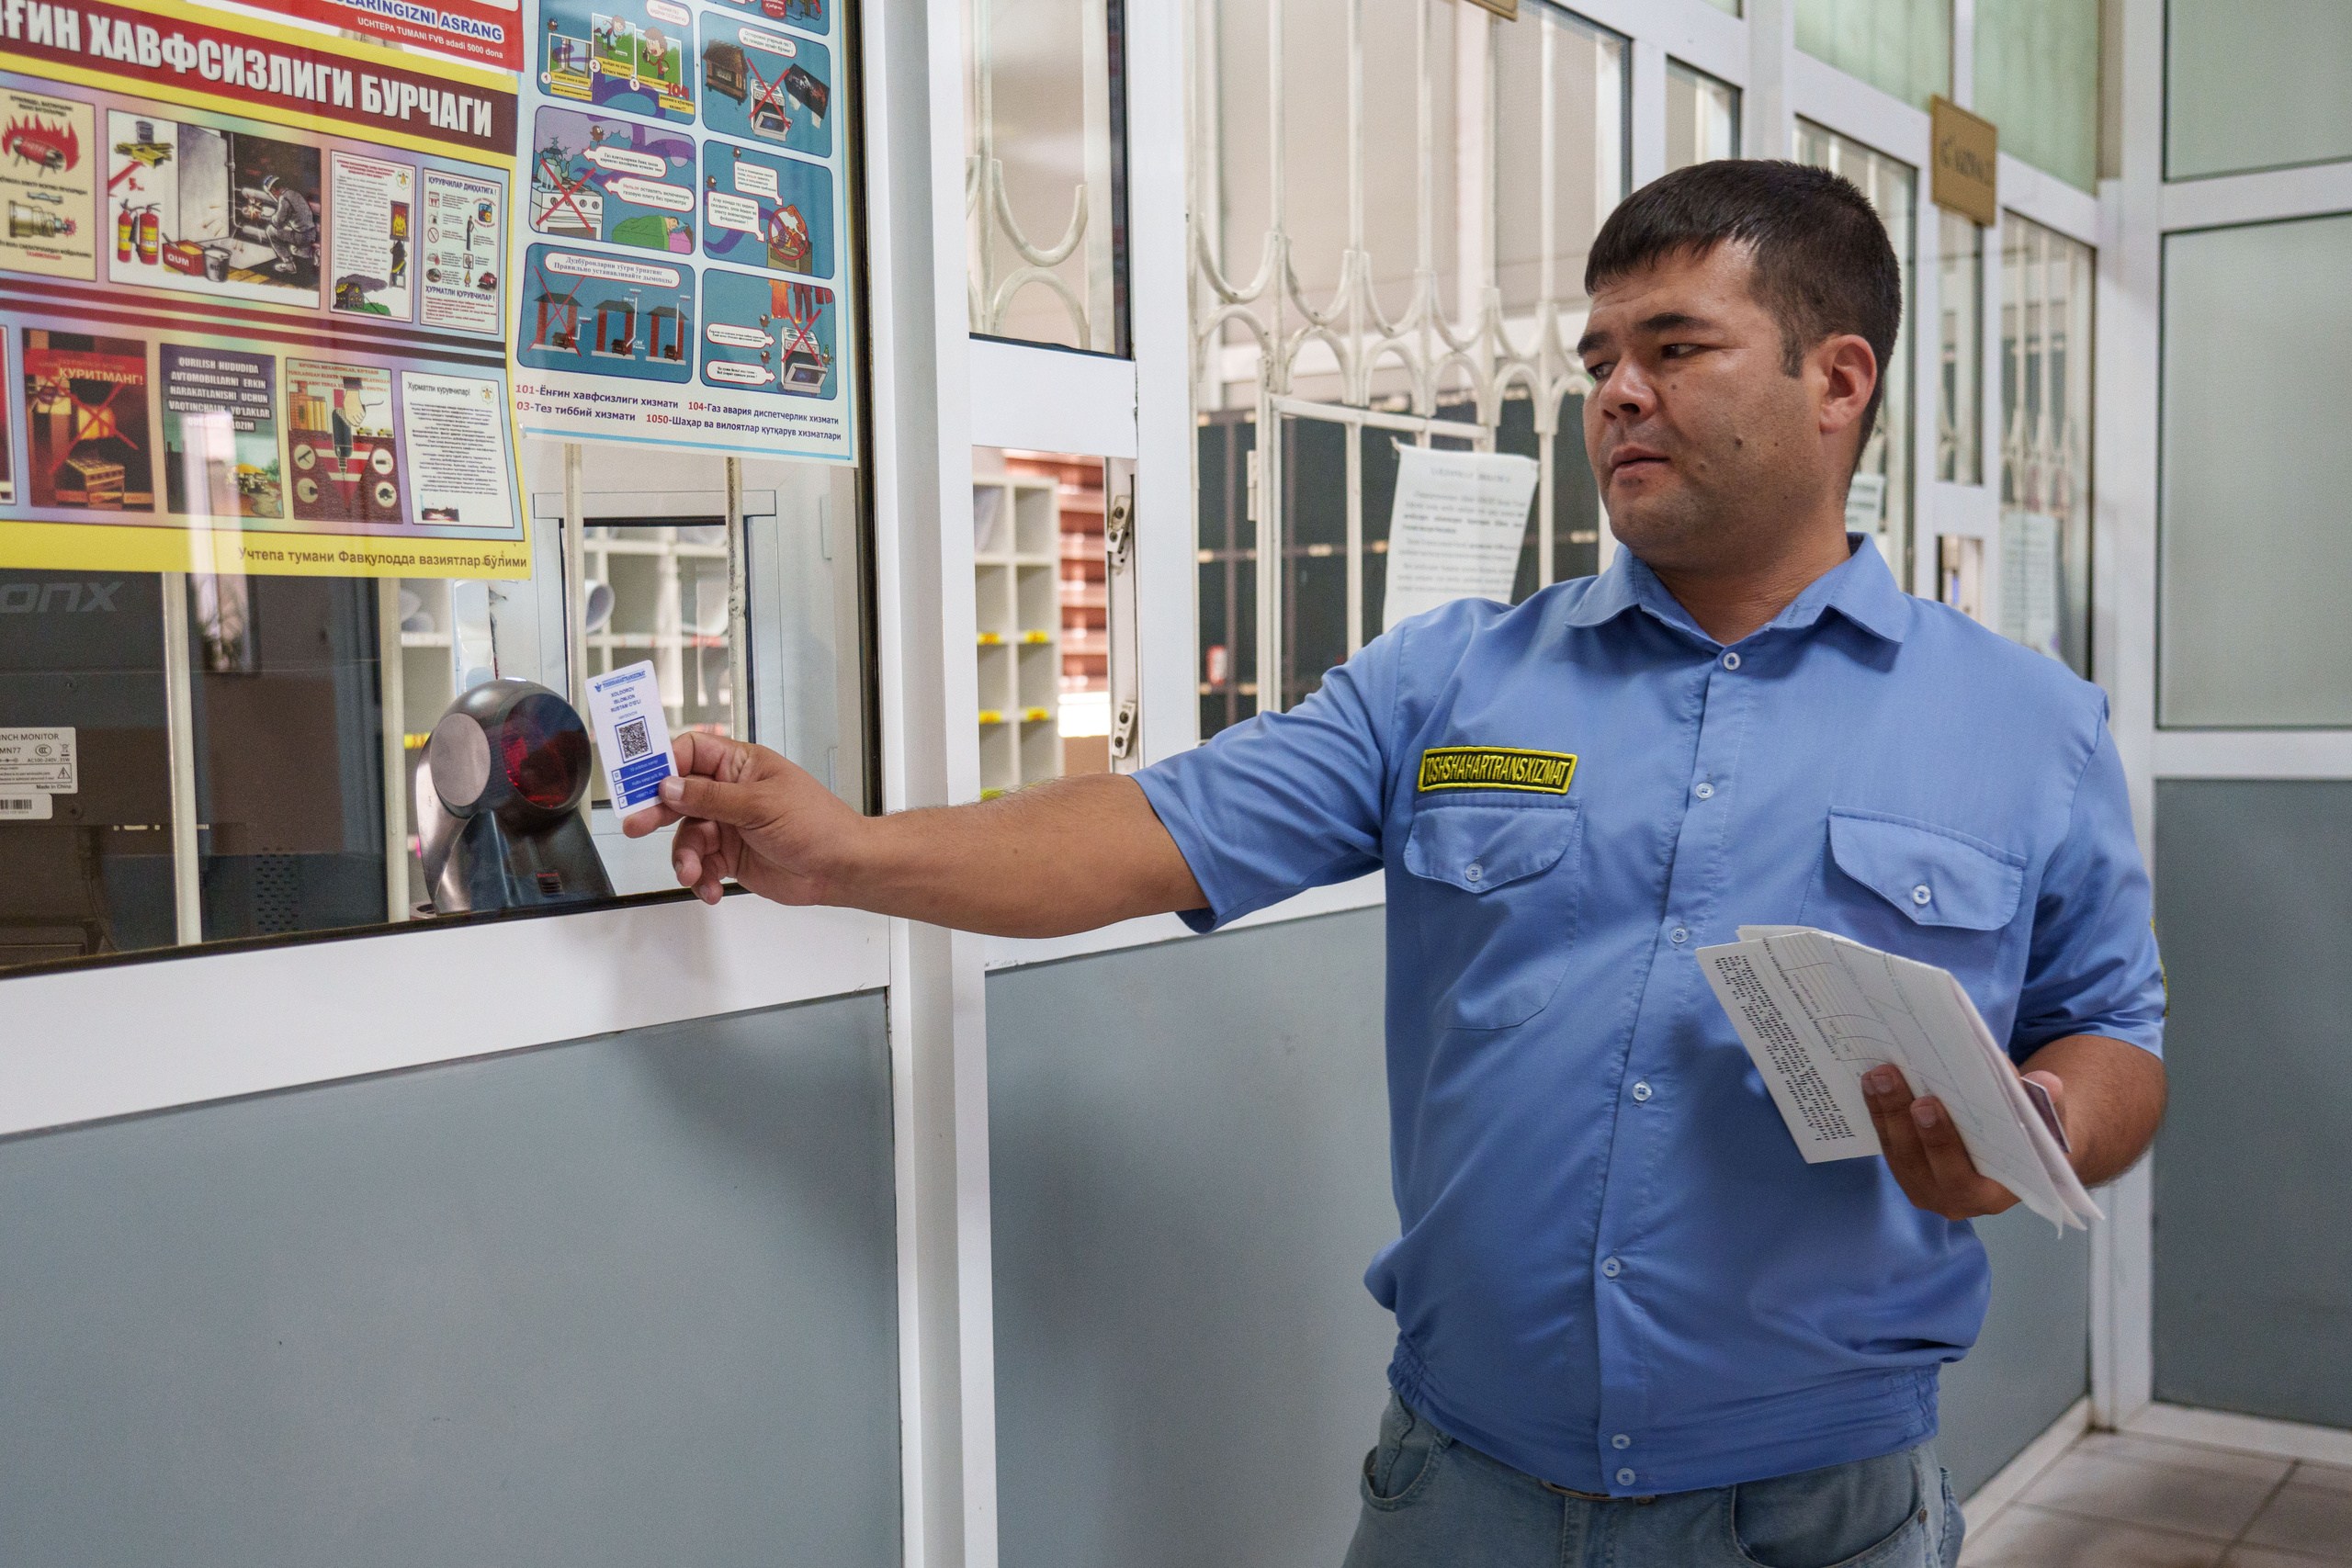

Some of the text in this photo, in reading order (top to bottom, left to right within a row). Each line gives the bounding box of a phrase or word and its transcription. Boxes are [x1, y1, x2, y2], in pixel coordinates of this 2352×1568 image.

[336, 0, 503, 40] ARINGIZNI ASRANG
[357, 17, 503, 59] UCHTEPA TUMANI FVB adadi 5000 dona
[744, 30, 766, 41] Осторожно
[87, 13, 354, 109] ХАВФСИЗЛИГИ
[360, 73, 492, 139] БУРЧАГИ
[666, 81, 689, 101] 104
[428, 175, 463, 190] ҚУРУВЧИЛАР
[463, 183, 493, 196] ДИҚҚАТИГА
[623, 183, 639, 191] Нельзя
[623, 190, 641, 198] газовую
[166, 254, 189, 266] QUM
[593, 267, 641, 279] устанавливайте
[457, 290, 492, 301] ҚУРУВЧИЛАР
[178, 356, 259, 374] QURILISH HUDUDIDA
[171, 371, 266, 389] AVTOMOBILLARNI ERKIN
[169, 386, 268, 403] HARAKATLANISHI UCHUN
[515, 384, 679, 409] 101-Ёнғин хавфсизлиги хизмати
[168, 400, 270, 418] VAQTINCHALIK YO'LAKLAR
[516, 401, 636, 422] 03-Тез тиббий хизмати
[688, 401, 839, 424] 104-Газ авария диспетчерлик хизмати
[232, 420, 254, 431] LOZIM
[646, 414, 702, 428] 1050-Шаҳар
[716, 423, 760, 433] вилоятлар
[761, 426, 797, 436] қутқарув
[797, 430, 842, 441] хизматлари
[238, 547, 527, 569] Учтепа тумани Фавқулодда вазиятлар бўлими
[1424, 754, 1570, 786] TOSHSHAHARTRANSXIZMAT
[1714, 958, 1732, 985] boylik
[1735, 956, 1741, 965] va
[1732, 991, 1740, 999] va
[1741, 1006, 1764, 1038] manfaat
[1768, 1010, 1790, 1041] moddiy,
[1720, 958, 1830, 1140] orttirish maqsadida foydalanish, naqd pul
[1728, 957, 1838, 1139] tushumini to'liq topshirmaslik, yo'lovchilarga
[1788, 1043, 1805, 1067] uchun
[1804, 1071, 1830, 1111] bermaslik
[1809, 1066, 1841, 1111] javobgarlik
[1785, 1080, 1815, 1128] Avtobusdan
[1828, 1113, 1847, 1138] chipta
[1838, 1115, 1856, 1137] jinoiy
